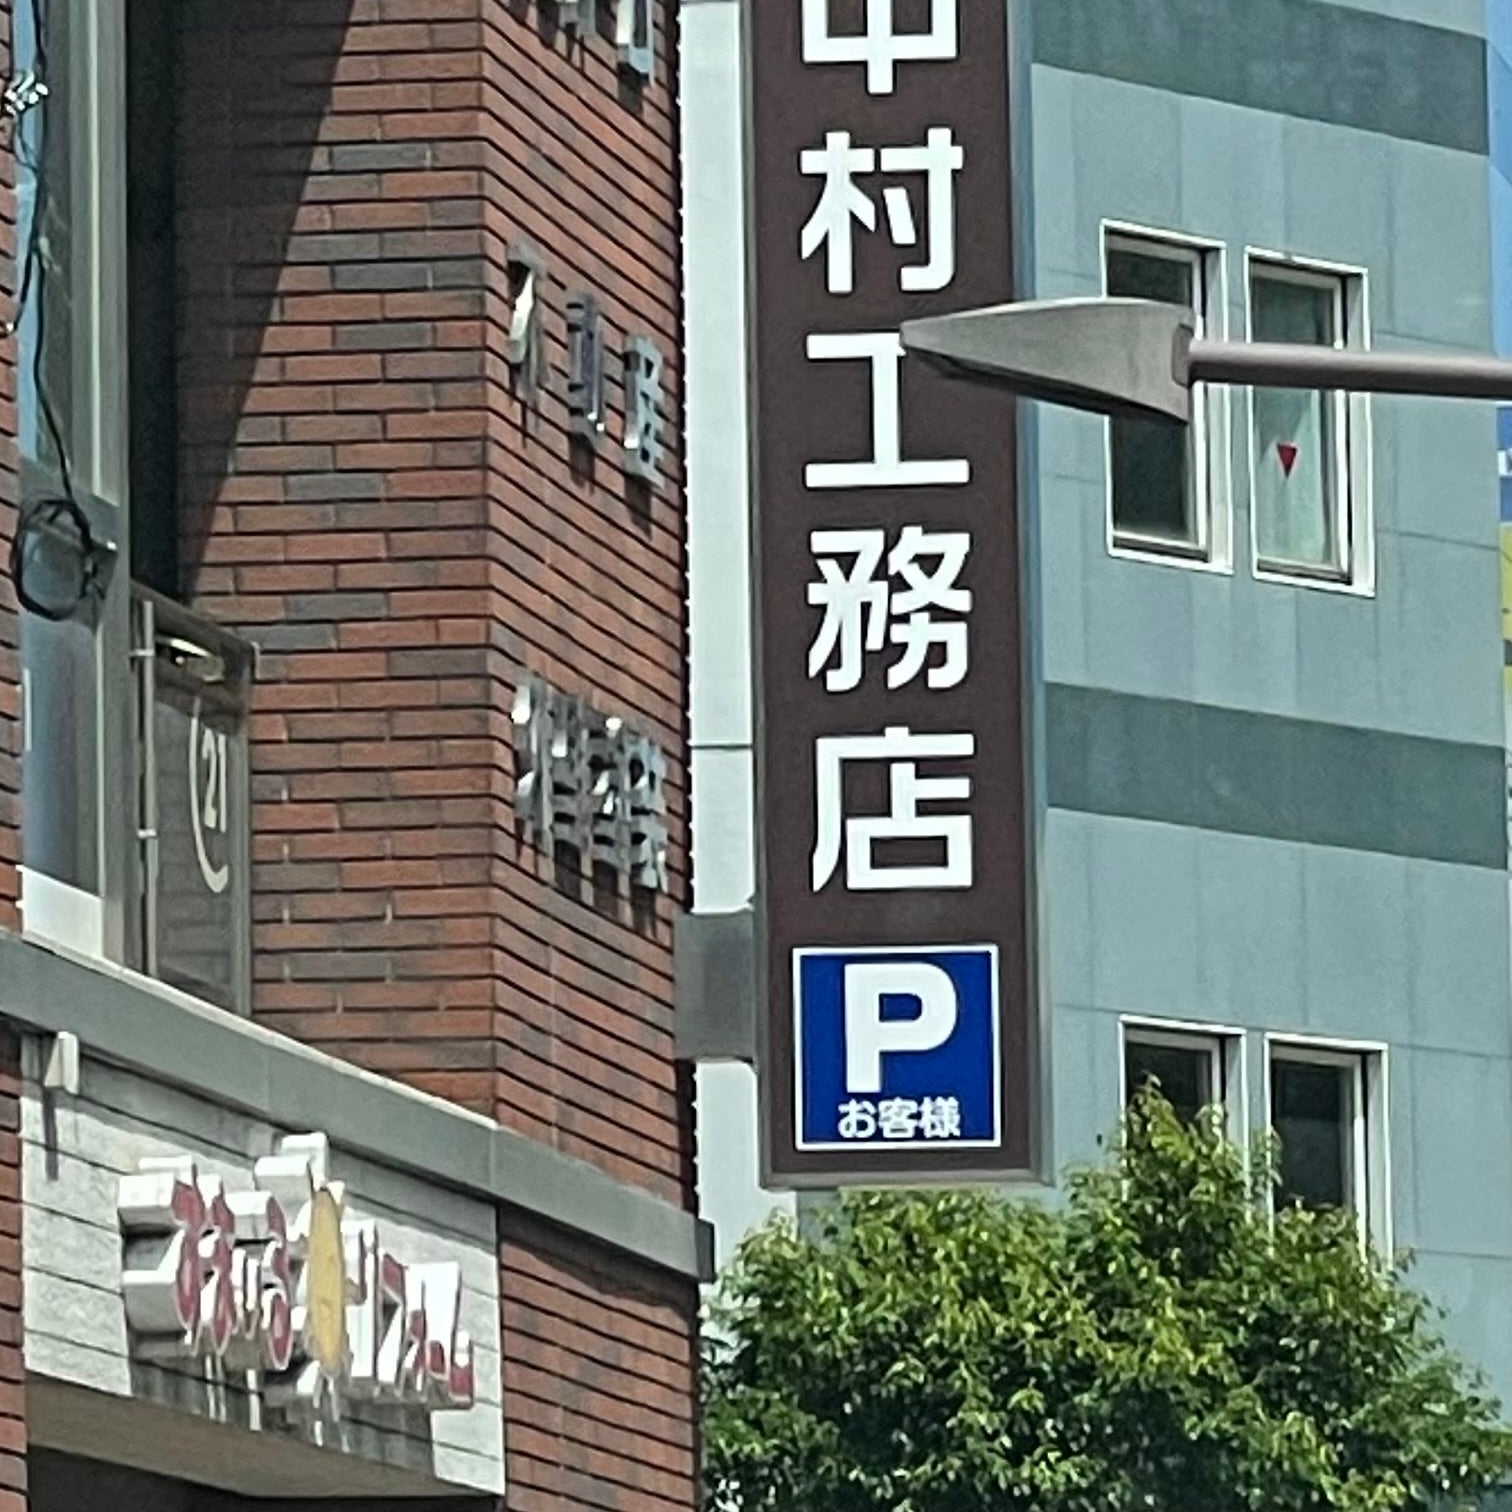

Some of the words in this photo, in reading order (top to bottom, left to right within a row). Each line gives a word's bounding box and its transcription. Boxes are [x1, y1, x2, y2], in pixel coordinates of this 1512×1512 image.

[843, 961, 959, 1094] P
[836, 1095, 962, 1141] お客様
